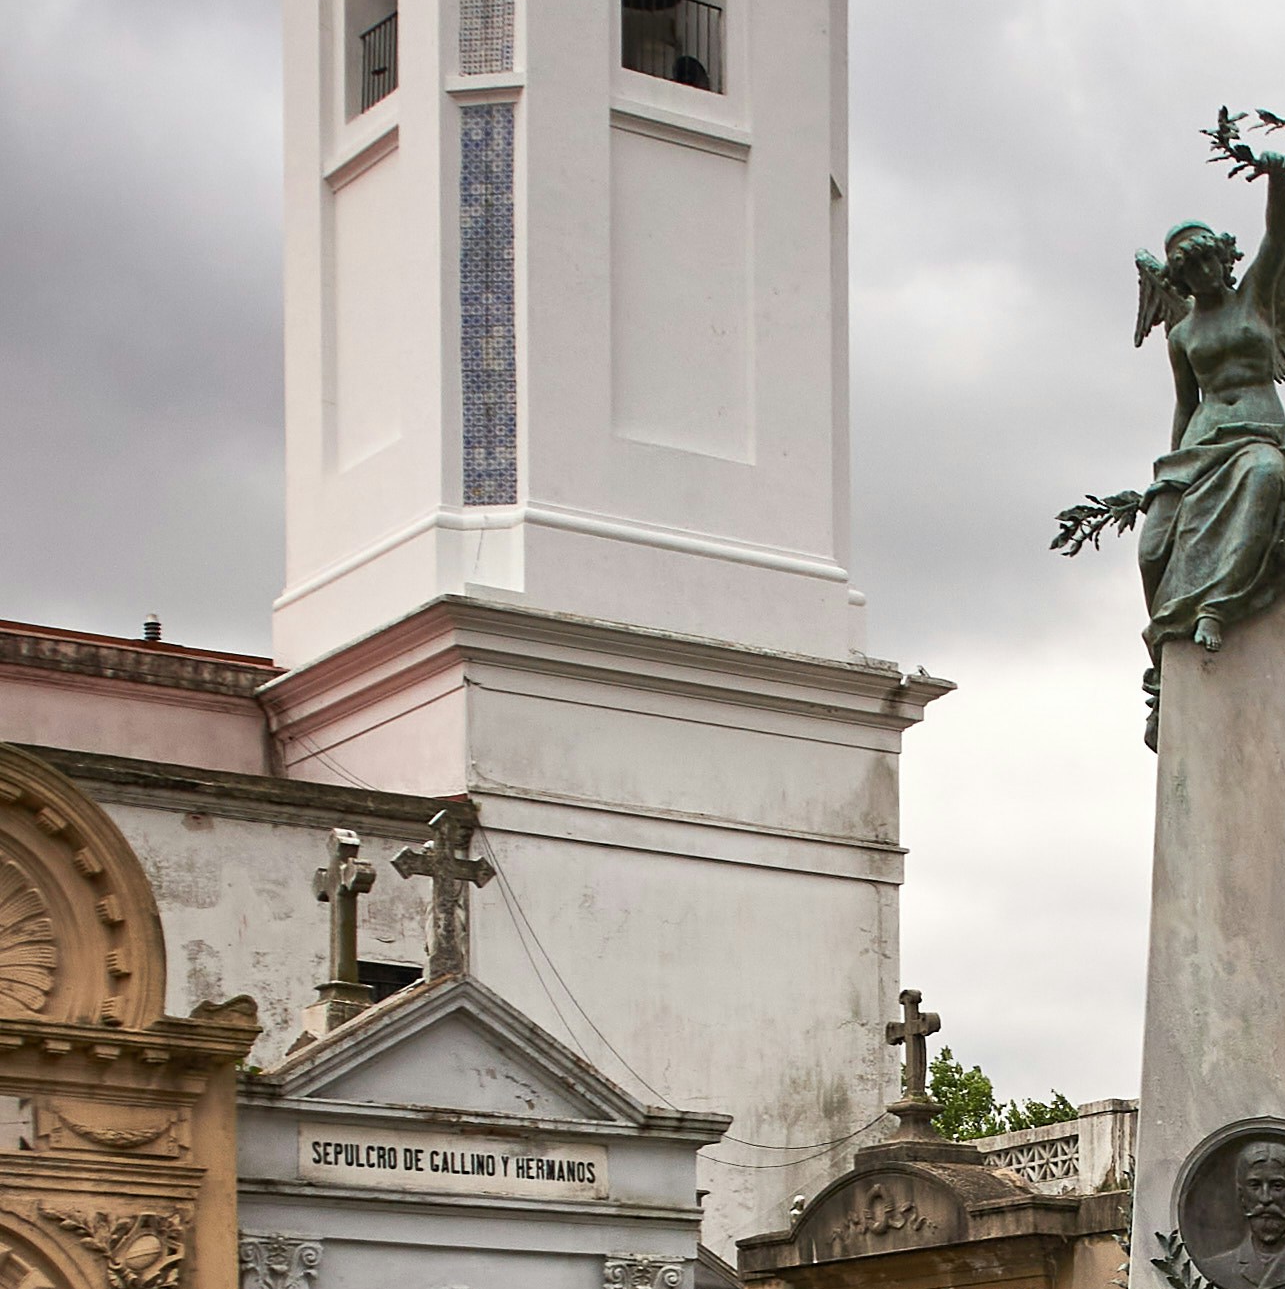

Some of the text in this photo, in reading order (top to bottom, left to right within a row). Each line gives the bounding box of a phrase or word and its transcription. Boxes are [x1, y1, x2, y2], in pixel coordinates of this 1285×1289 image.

[311, 1140, 597, 1185] SEPULCRO DE GALLINO Y HERMANOS
